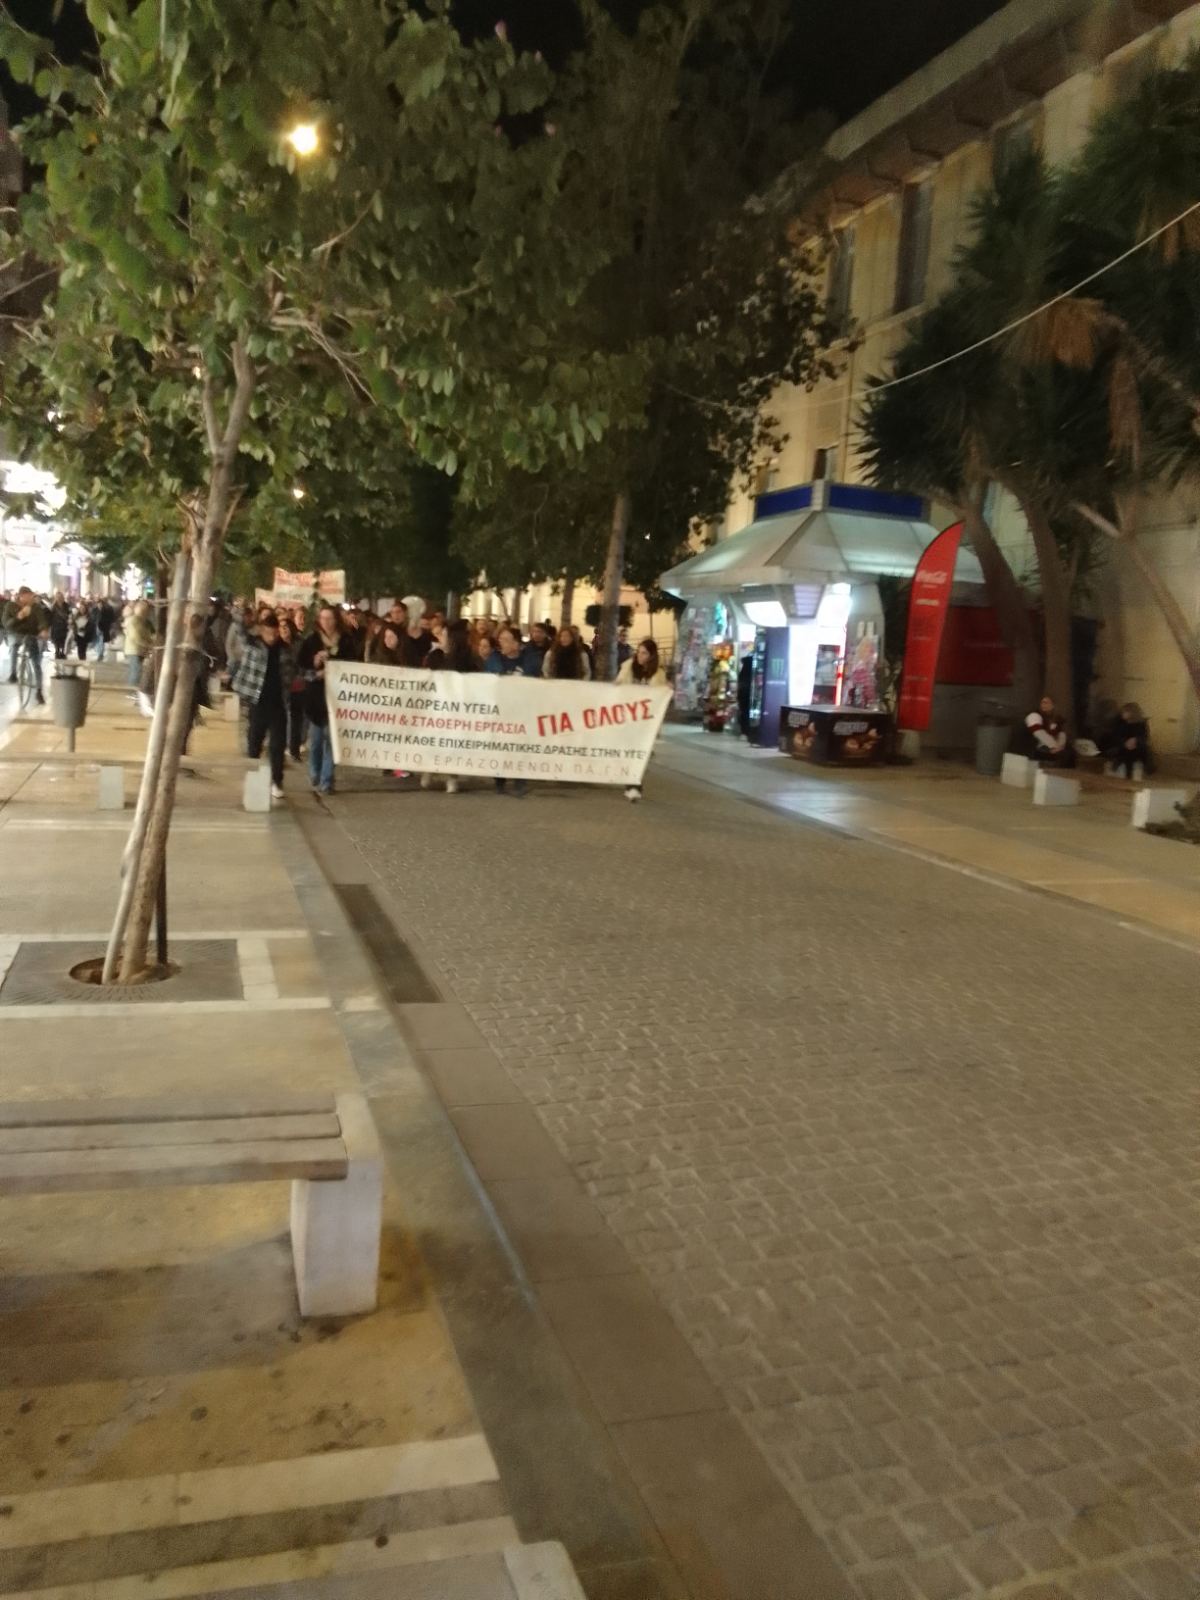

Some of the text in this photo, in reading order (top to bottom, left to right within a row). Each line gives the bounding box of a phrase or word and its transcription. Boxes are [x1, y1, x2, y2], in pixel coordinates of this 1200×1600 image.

[340, 672, 437, 692] ΑΠΟΚΛΕΙΣΤΙΚΑ
[337, 690, 500, 715] ΔΗΜΟΣΙΑ ΔΩΡΕΑΝ ΥΓΕΙΑ
[335, 708, 527, 735] ΜΟΝΙΜΗ & ΣΤΑΘΕΡΗ ΕΡΓΑΣΙΑ
[537, 699, 654, 737] ΓΙΑ ΟΛΟΥΣ
[404, 735, 436, 747] ΚΑΘΕ
[439, 737, 541, 754] ΕΠΙΧΕΙΡΗΜΑΤΙΚΗΣ
[544, 744, 588, 757] ΔΡΑΣΗΣ
[342, 747, 422, 764] ΩΜΑΤΕΙΟ
[434, 755, 564, 773] ΕΡΓΑΖΟΜΕΝΩΝ
